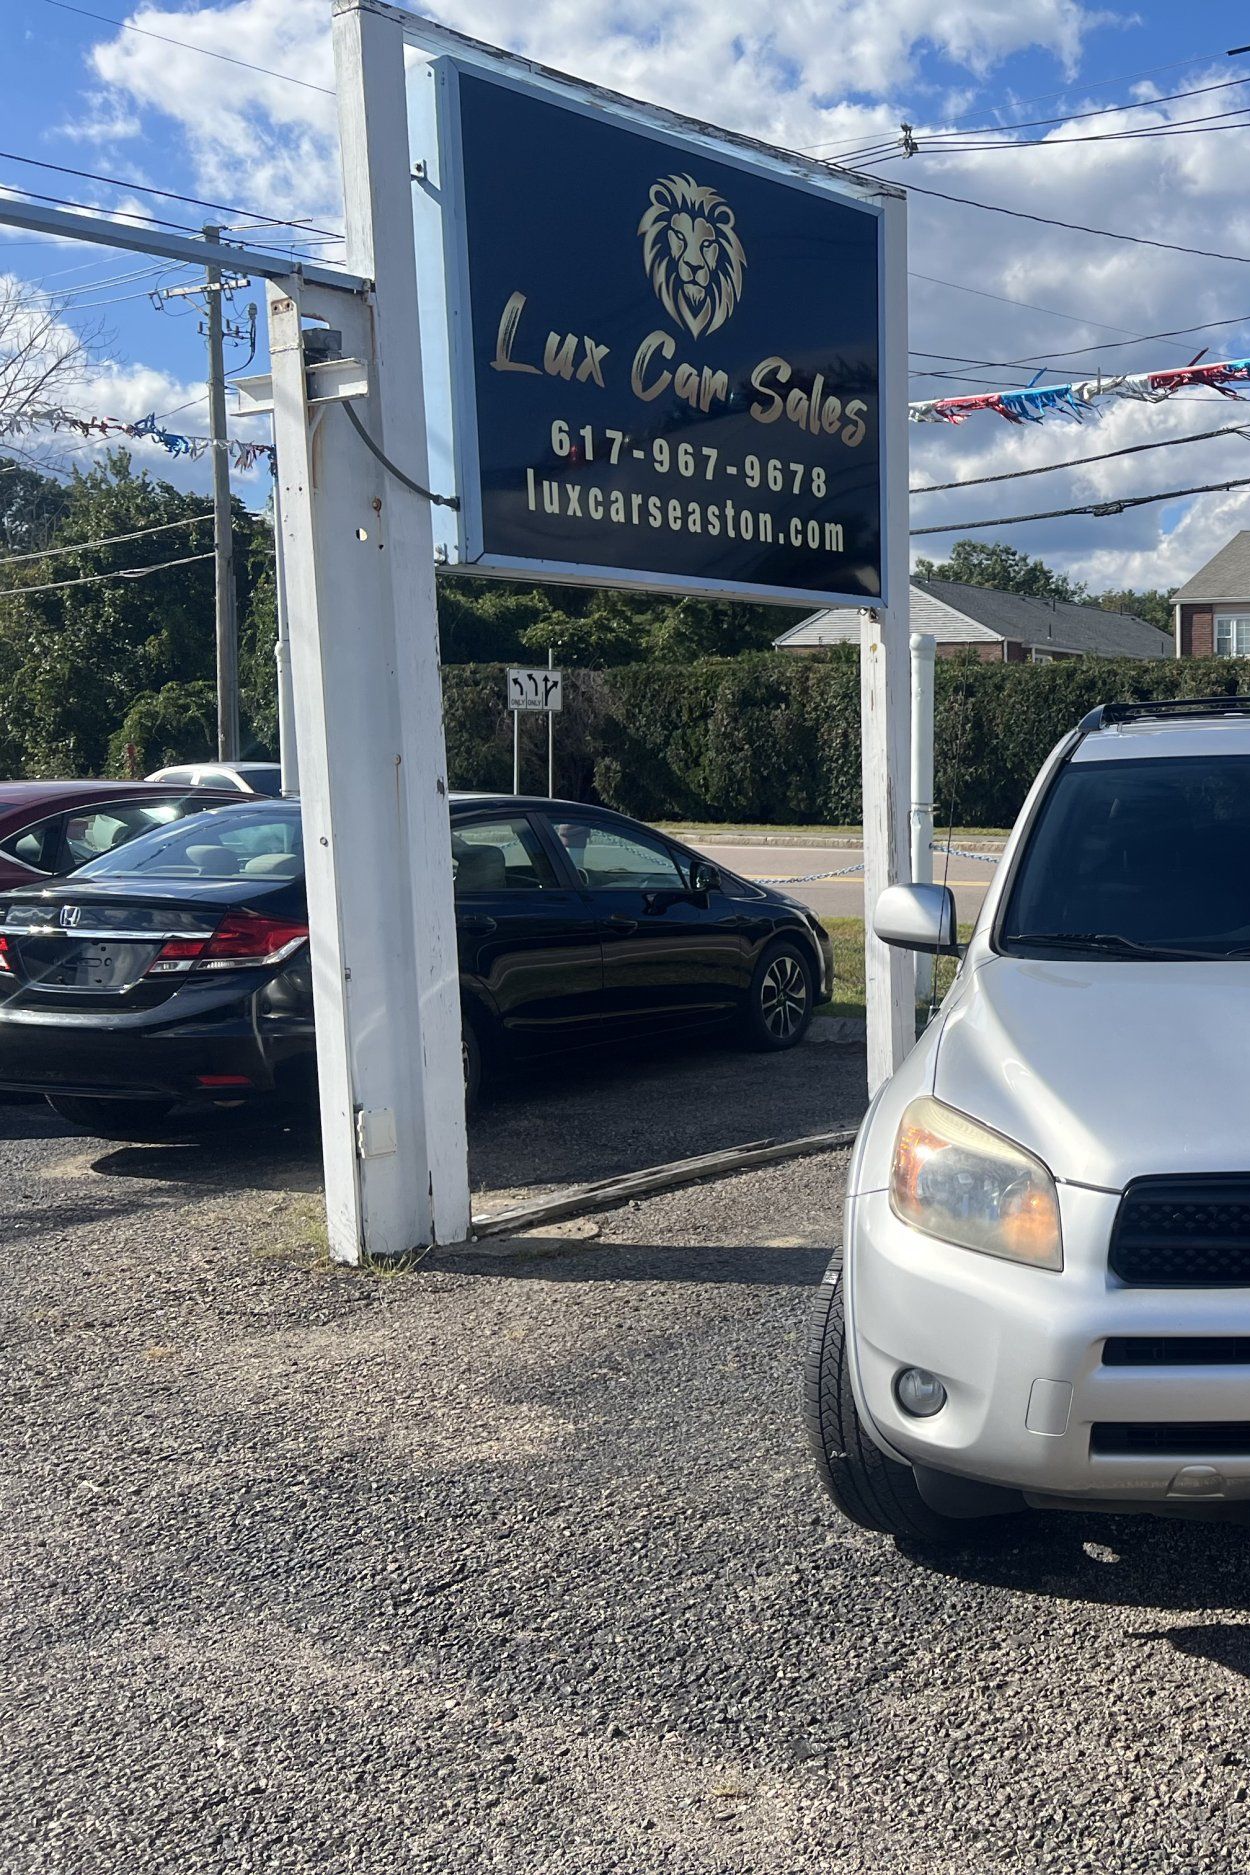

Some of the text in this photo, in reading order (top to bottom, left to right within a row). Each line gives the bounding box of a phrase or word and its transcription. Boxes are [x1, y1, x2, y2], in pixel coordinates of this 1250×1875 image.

[490, 292, 869, 448] Lux Car Sales
[551, 420, 828, 498] 617-967-9678
[526, 468, 845, 552] luxcarseaston.com
[511, 698, 526, 706] ONLY
